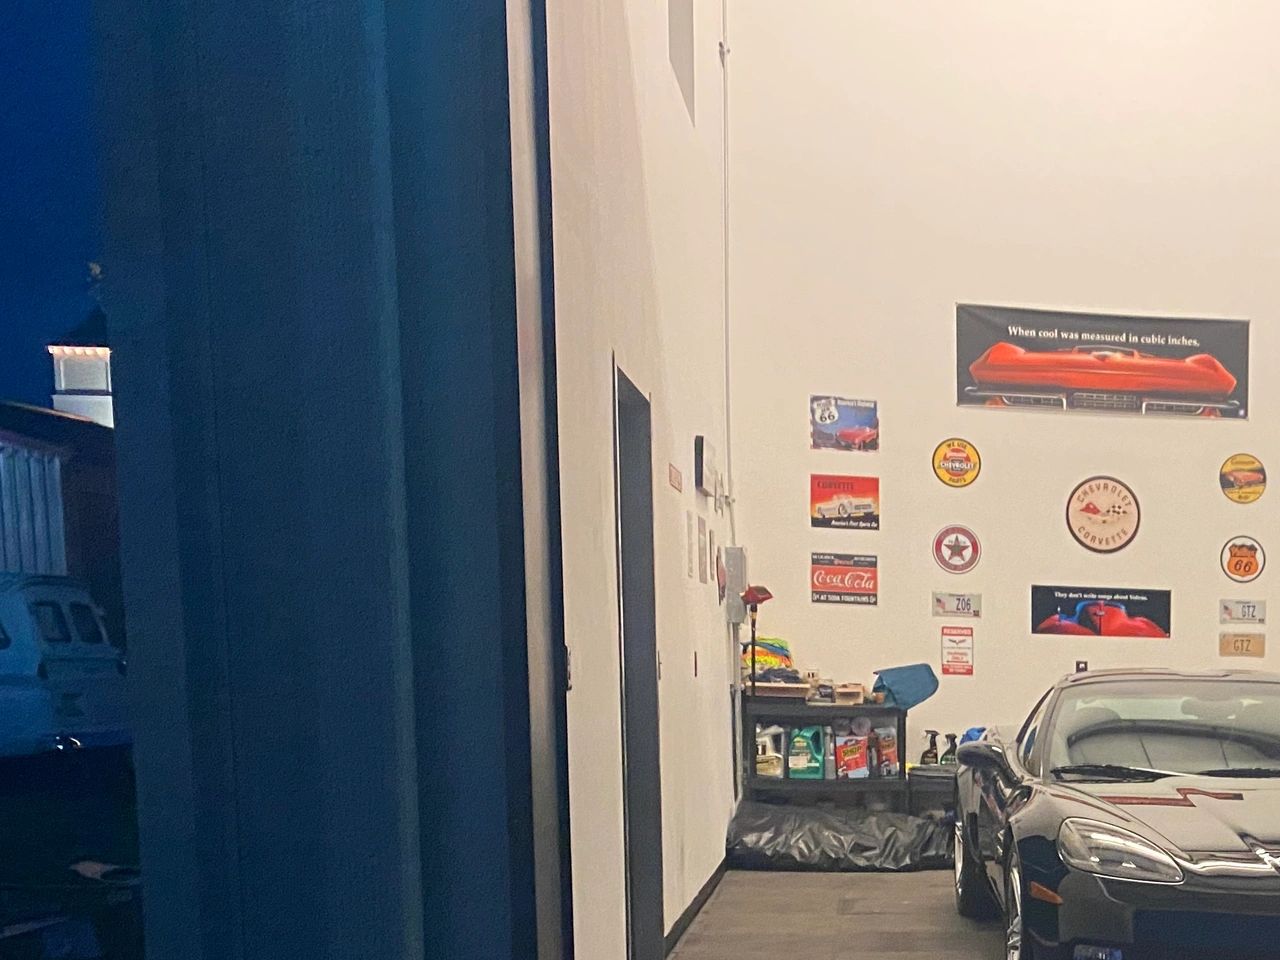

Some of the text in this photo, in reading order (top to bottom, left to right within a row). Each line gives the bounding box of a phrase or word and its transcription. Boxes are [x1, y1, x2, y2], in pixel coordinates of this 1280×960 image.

[1007, 325, 1200, 347] When cool was measured in cubic inches.
[819, 411, 836, 422] 66
[1076, 482, 1132, 507] CHEVROLET
[1077, 526, 1129, 546] CORVETTE
[1234, 559, 1253, 573] 66
[1054, 591, 1067, 599] They
[1241, 604, 1256, 618] GTZ
[1233, 639, 1251, 652] GTZ
